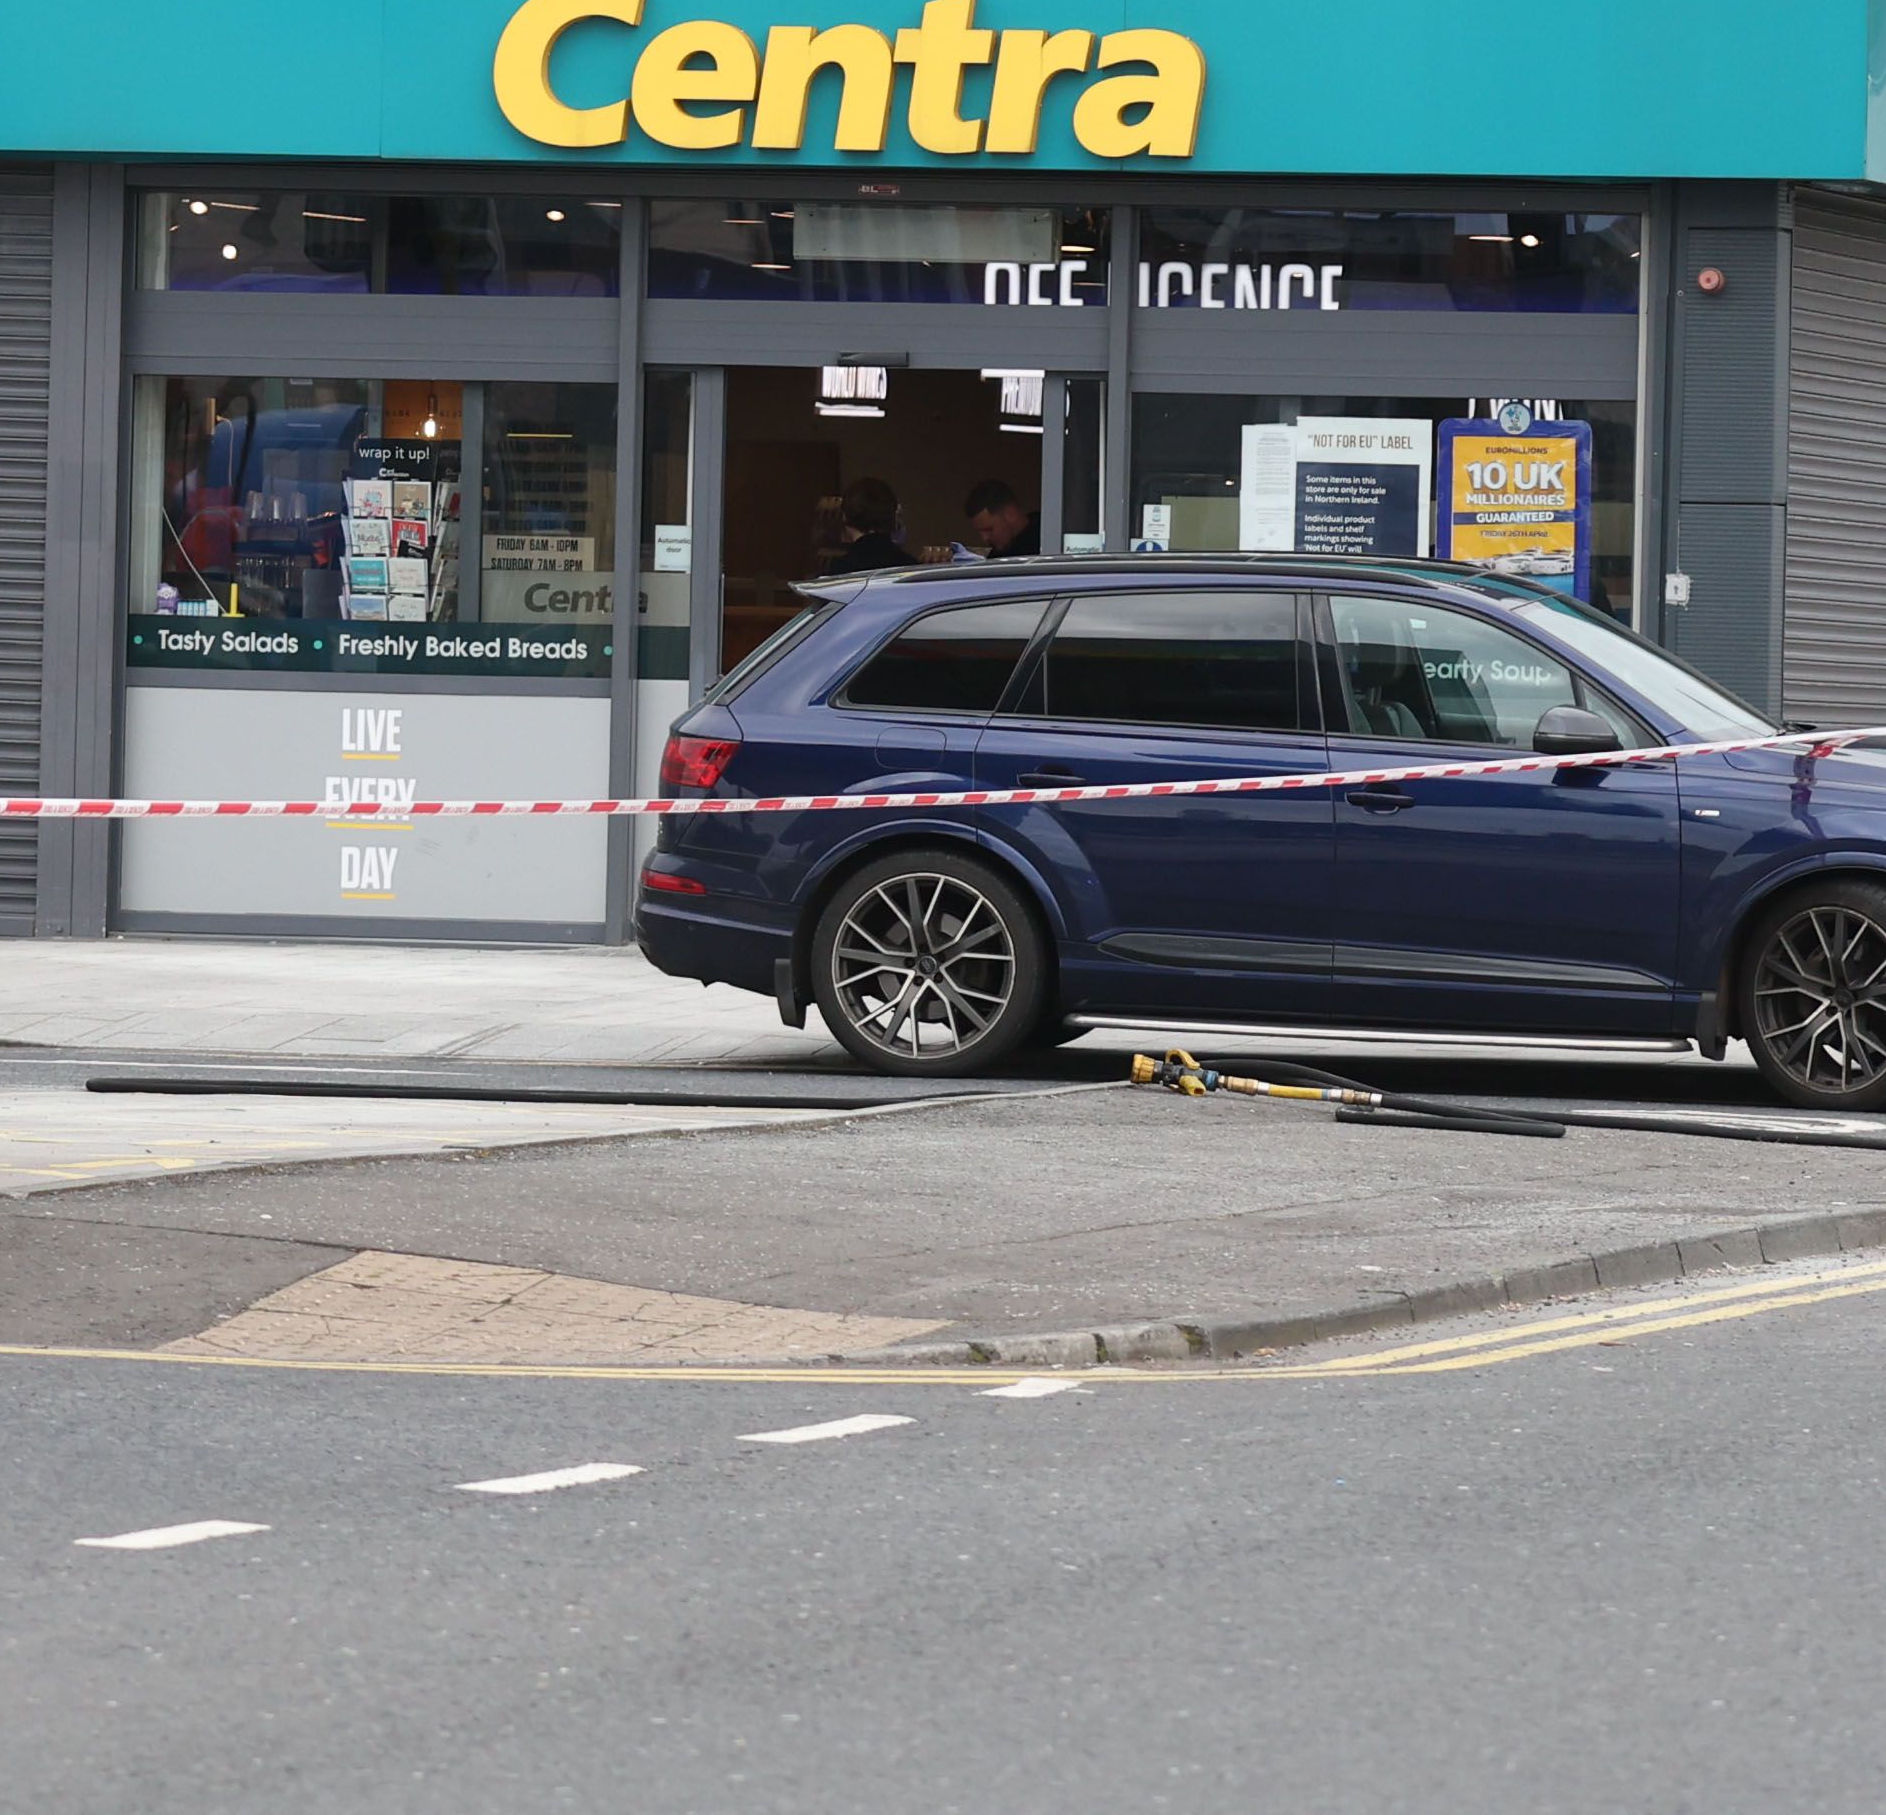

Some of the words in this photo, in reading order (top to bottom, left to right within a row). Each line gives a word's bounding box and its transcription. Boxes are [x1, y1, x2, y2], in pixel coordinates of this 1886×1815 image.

[1336, 435, 1356, 448] FOR
[1381, 436, 1413, 449] LABEL
[359, 447, 391, 462] wrap
[395, 446, 404, 460] it
[408, 447, 430, 464] up!
[1306, 475, 1328, 484] Some
[1330, 475, 1352, 484] items
[1353, 476, 1361, 484] in
[1362, 476, 1376, 485] this
[1466, 461, 1508, 491] 10
[1514, 462, 1564, 490] UK
[1306, 486, 1327, 494] store
[1340, 486, 1358, 496] only
[1359, 486, 1370, 495] for
[1371, 487, 1386, 495] sale
[1305, 495, 1313, 503] in
[1315, 496, 1350, 504] Northern
[1351, 496, 1380, 504] Ireland.
[1466, 493, 1565, 506] MILLIONAIRES
[1304, 515, 1343, 523] Individual
[1344, 516, 1375, 525] product
[1476, 511, 1554, 523] GUARANTEED
[1304, 525, 1327, 533] labels
[1329, 525, 1344, 533] and
[1345, 525, 1365, 533] shelf
[497, 538, 525, 551] FRIDAY
[1304, 535, 1340, 544] markings
[1341, 535, 1374, 544] showing
[1321, 544, 1332, 553] for
[1347, 545, 1362, 553] will
[491, 558, 533, 571] SATURDAY
[538, 559, 556, 571] 7AM
[158, 630, 216, 656] Tasty
[222, 631, 299, 654] Salads
[339, 633, 418, 661] Freshly
[425, 636, 501, 659] Baked
[507, 638, 588, 661] Breads
[342, 708, 402, 752] LIVE
[325, 776, 416, 821] EVERY
[341, 847, 398, 889] DAY
